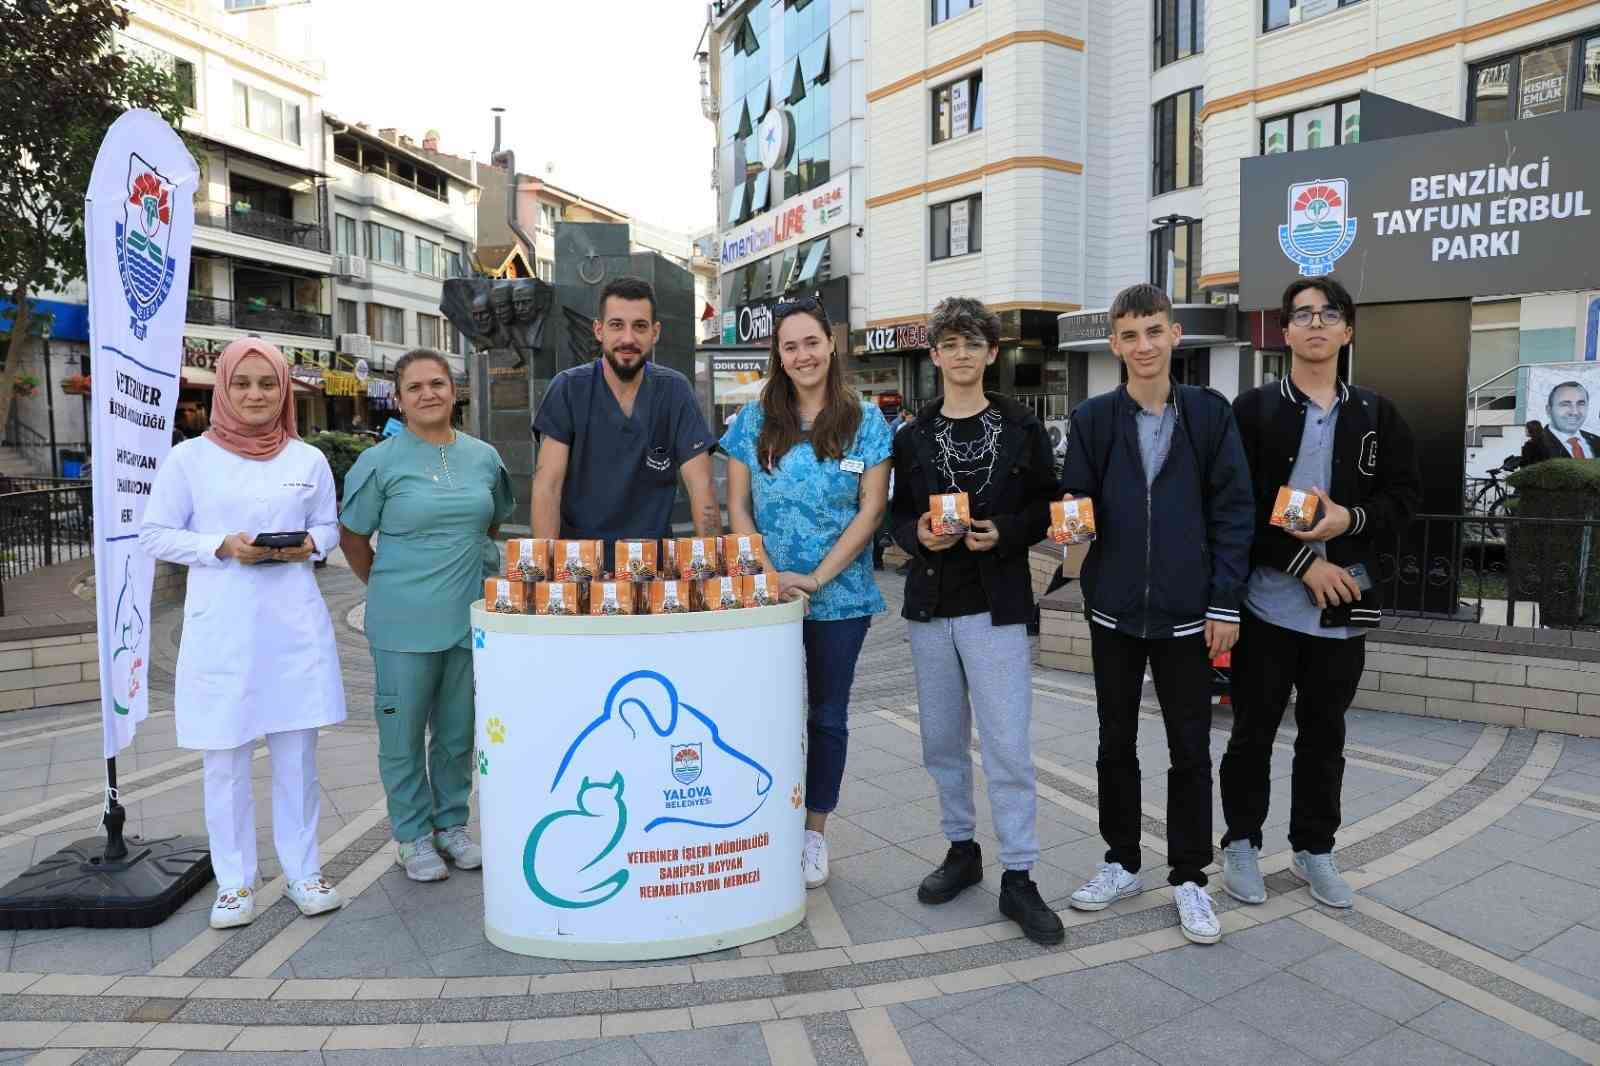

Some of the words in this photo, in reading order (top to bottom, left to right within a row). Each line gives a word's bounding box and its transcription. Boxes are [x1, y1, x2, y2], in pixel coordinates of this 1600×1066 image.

[1523, 76, 1565, 95] KISMET
[1523, 87, 1562, 105] EMLAK
[1409, 156, 1550, 202] BENZİNCİ
[1372, 202, 1482, 236] TAYFUN
[1489, 190, 1591, 226] ERBUL
[1431, 230, 1520, 262] PARKI
[866, 327, 896, 352] KÖZ
[738, 361, 761, 370] USTA
[663, 786, 712, 801] YALOVA
[682, 843, 712, 860] İŞLERİ
[659, 863, 705, 880] SAHİPSİZ
[708, 857, 743, 874] HAYVAN
[639, 878, 720, 899] REHABİLİTASYON
[723, 868, 760, 889] MERKEZİ
